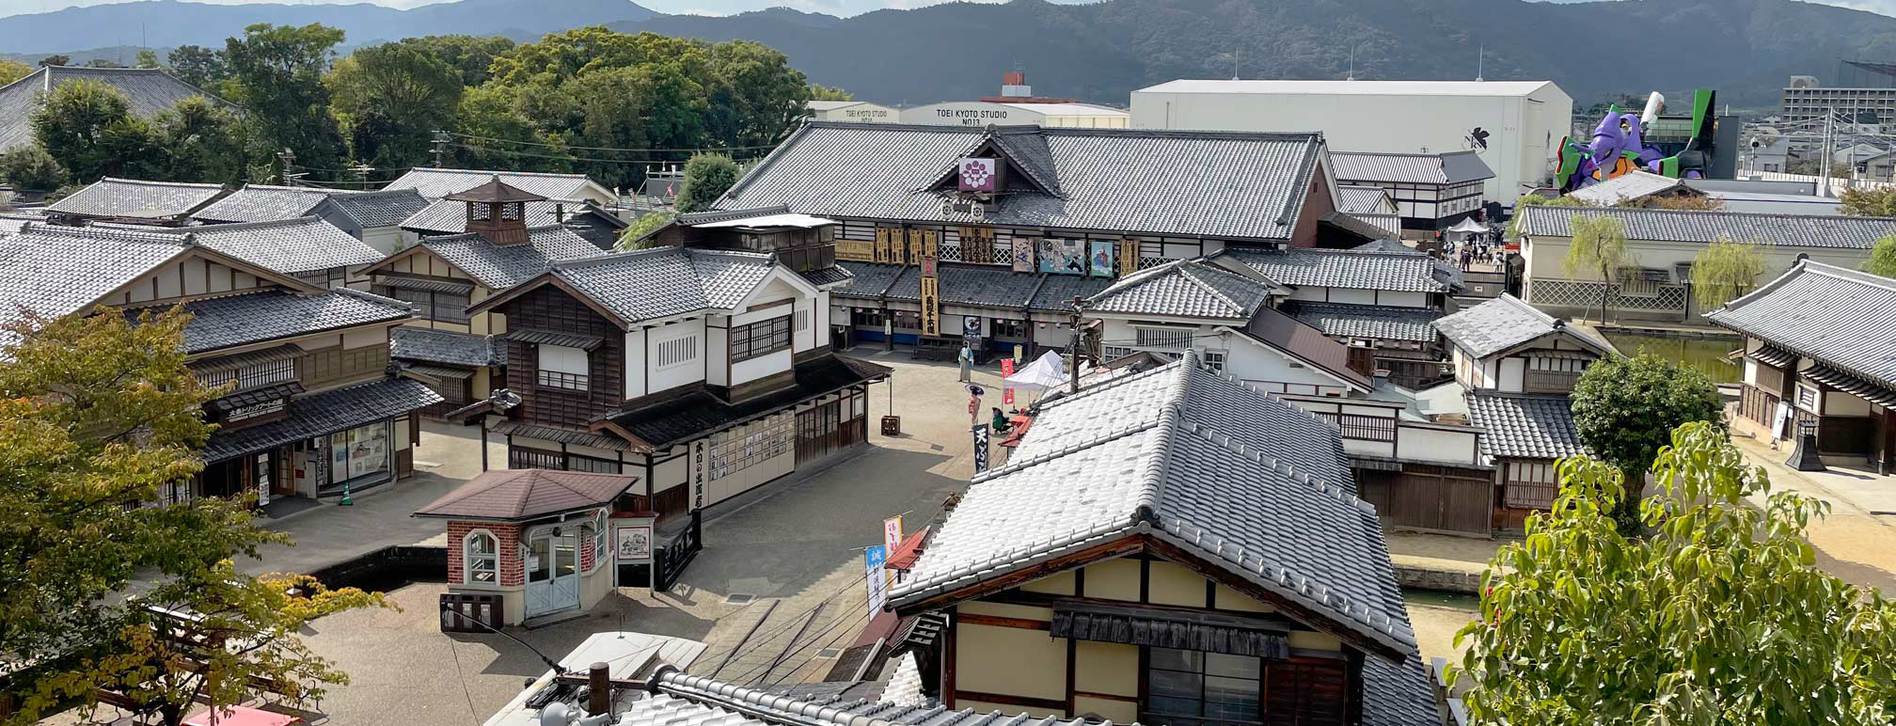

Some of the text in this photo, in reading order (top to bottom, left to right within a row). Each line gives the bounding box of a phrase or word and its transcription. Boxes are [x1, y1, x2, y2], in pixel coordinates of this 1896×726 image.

[872, 110, 888, 118] STUDIO
[936, 109, 1008, 119] TOEI KYOTO STUDIO
